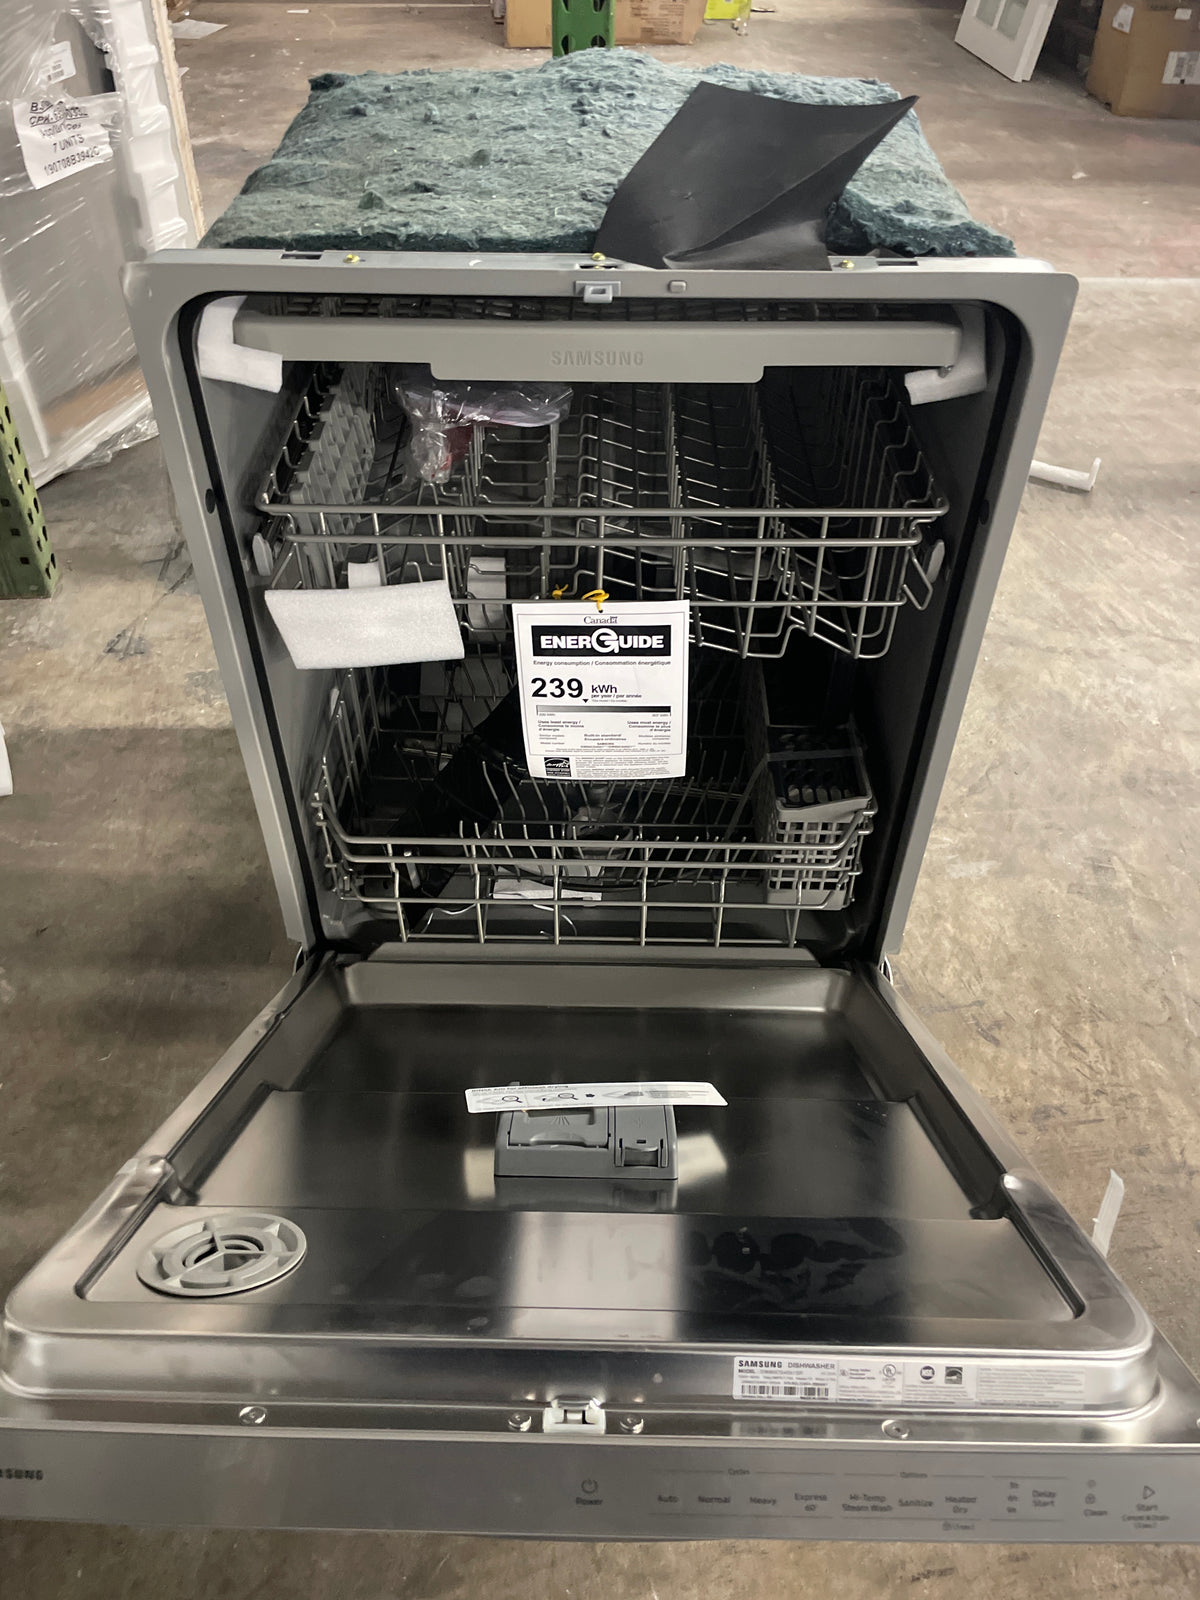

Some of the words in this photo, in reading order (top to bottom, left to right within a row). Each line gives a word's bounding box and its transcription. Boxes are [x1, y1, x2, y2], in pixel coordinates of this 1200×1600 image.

[52, 142, 58, 154] 7
[60, 134, 85, 151] UNITS
[551, 350, 645, 366] SAMSUNG
[583, 616, 618, 625] Canada
[540, 627, 665, 654] ENERGUIDE
[531, 677, 583, 699] 239
[591, 685, 618, 694] kWh
[738, 1360, 783, 1369] SAMSUNG
[787, 1362, 835, 1370] DISHWASHER
[794, 1493, 828, 1502] Express
[1032, 1490, 1056, 1498] Delay
[575, 1497, 603, 1506] Power
[657, 1495, 679, 1504] Auto
[698, 1495, 731, 1504] Normal
[750, 1496, 777, 1506] Heavy
[899, 1498, 934, 1507] Sanitize
[871, 1504, 893, 1512] Wash
[1136, 1503, 1158, 1511] Start
